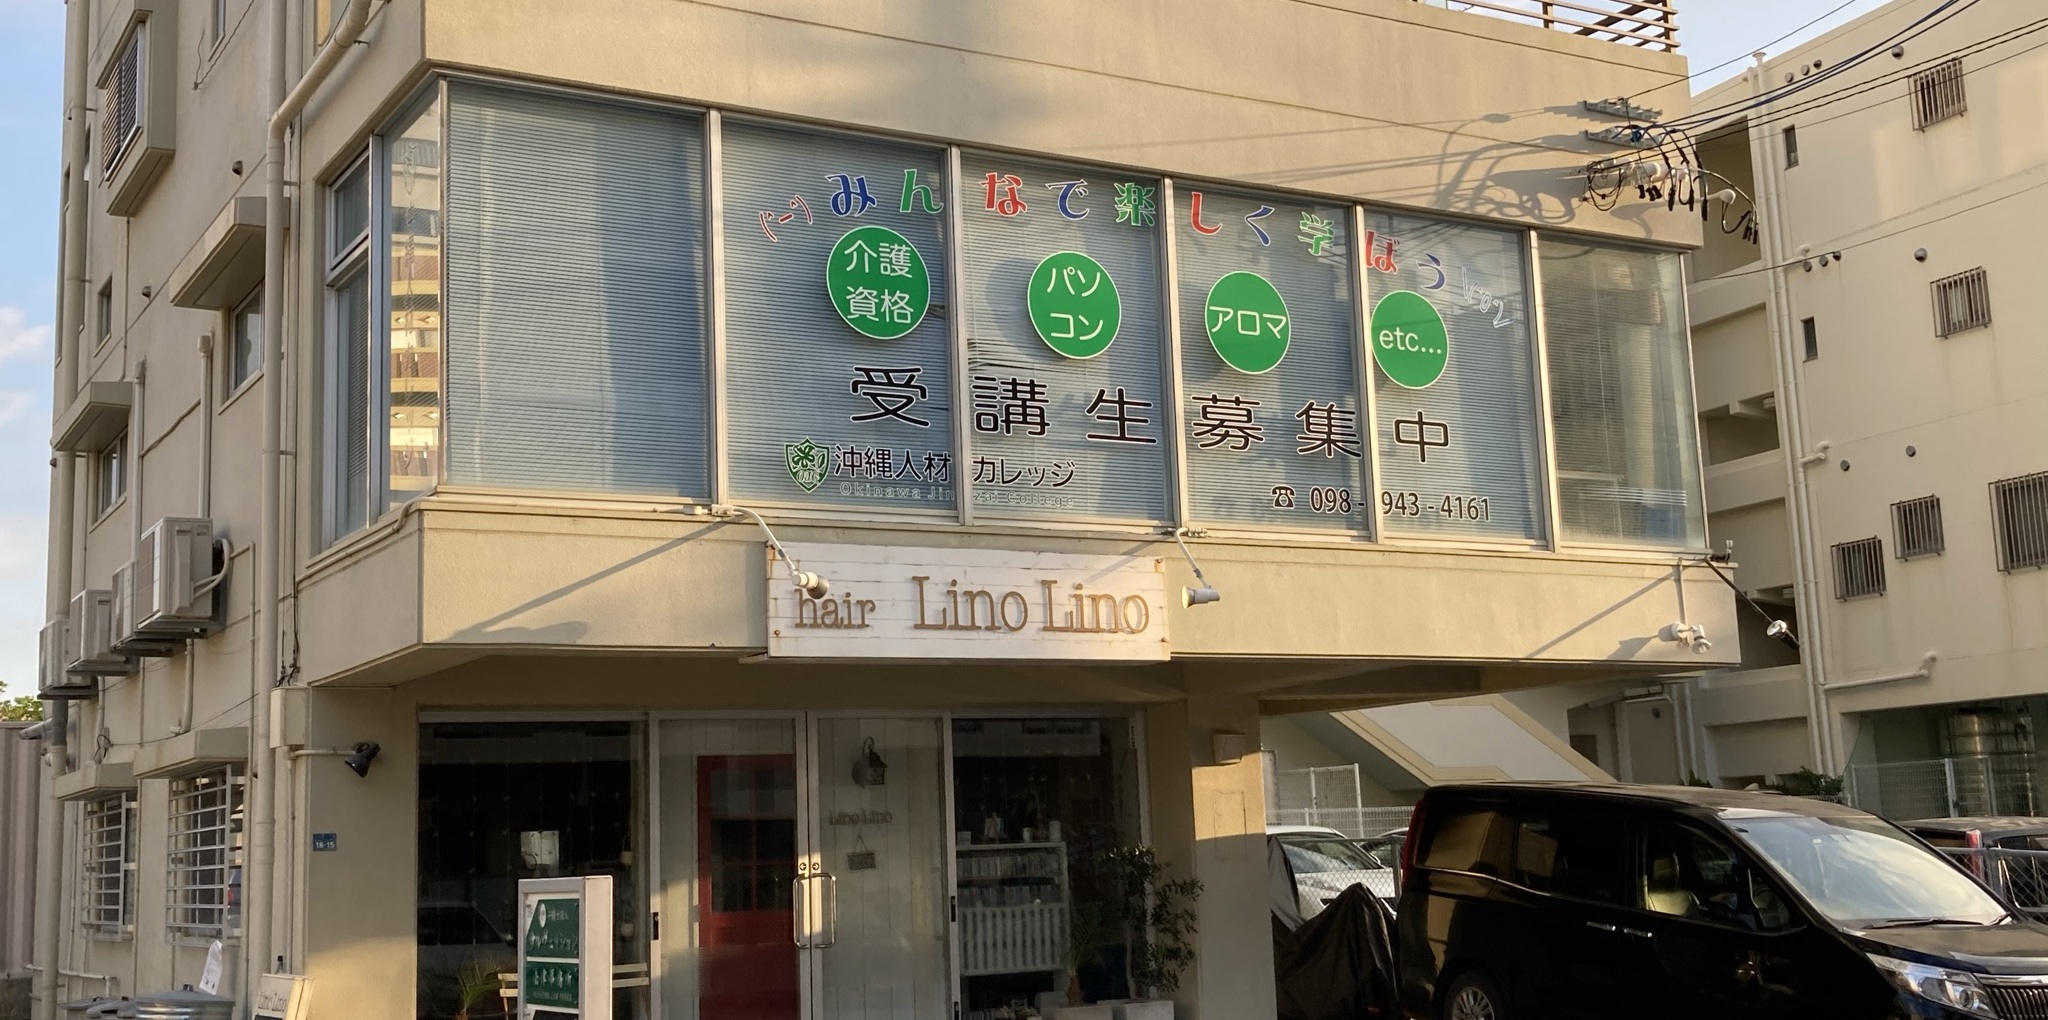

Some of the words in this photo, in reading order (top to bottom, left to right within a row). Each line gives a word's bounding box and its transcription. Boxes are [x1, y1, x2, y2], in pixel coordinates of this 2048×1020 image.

[844, 239, 913, 279] 介護
[1046, 266, 1102, 299] パソ
[845, 287, 914, 325] 資格
[1208, 305, 1288, 340] アロマ
[1050, 313, 1104, 341] コン
[1378, 326, 1443, 356] etc...
[849, 364, 1450, 464] 受講生募集中
[839, 481, 922, 499] Okinawa
[1006, 490, 1075, 508] College
[794, 588, 876, 630] hair
[912, 576, 1029, 632] Lino
[1041, 579, 1150, 634] Lino
